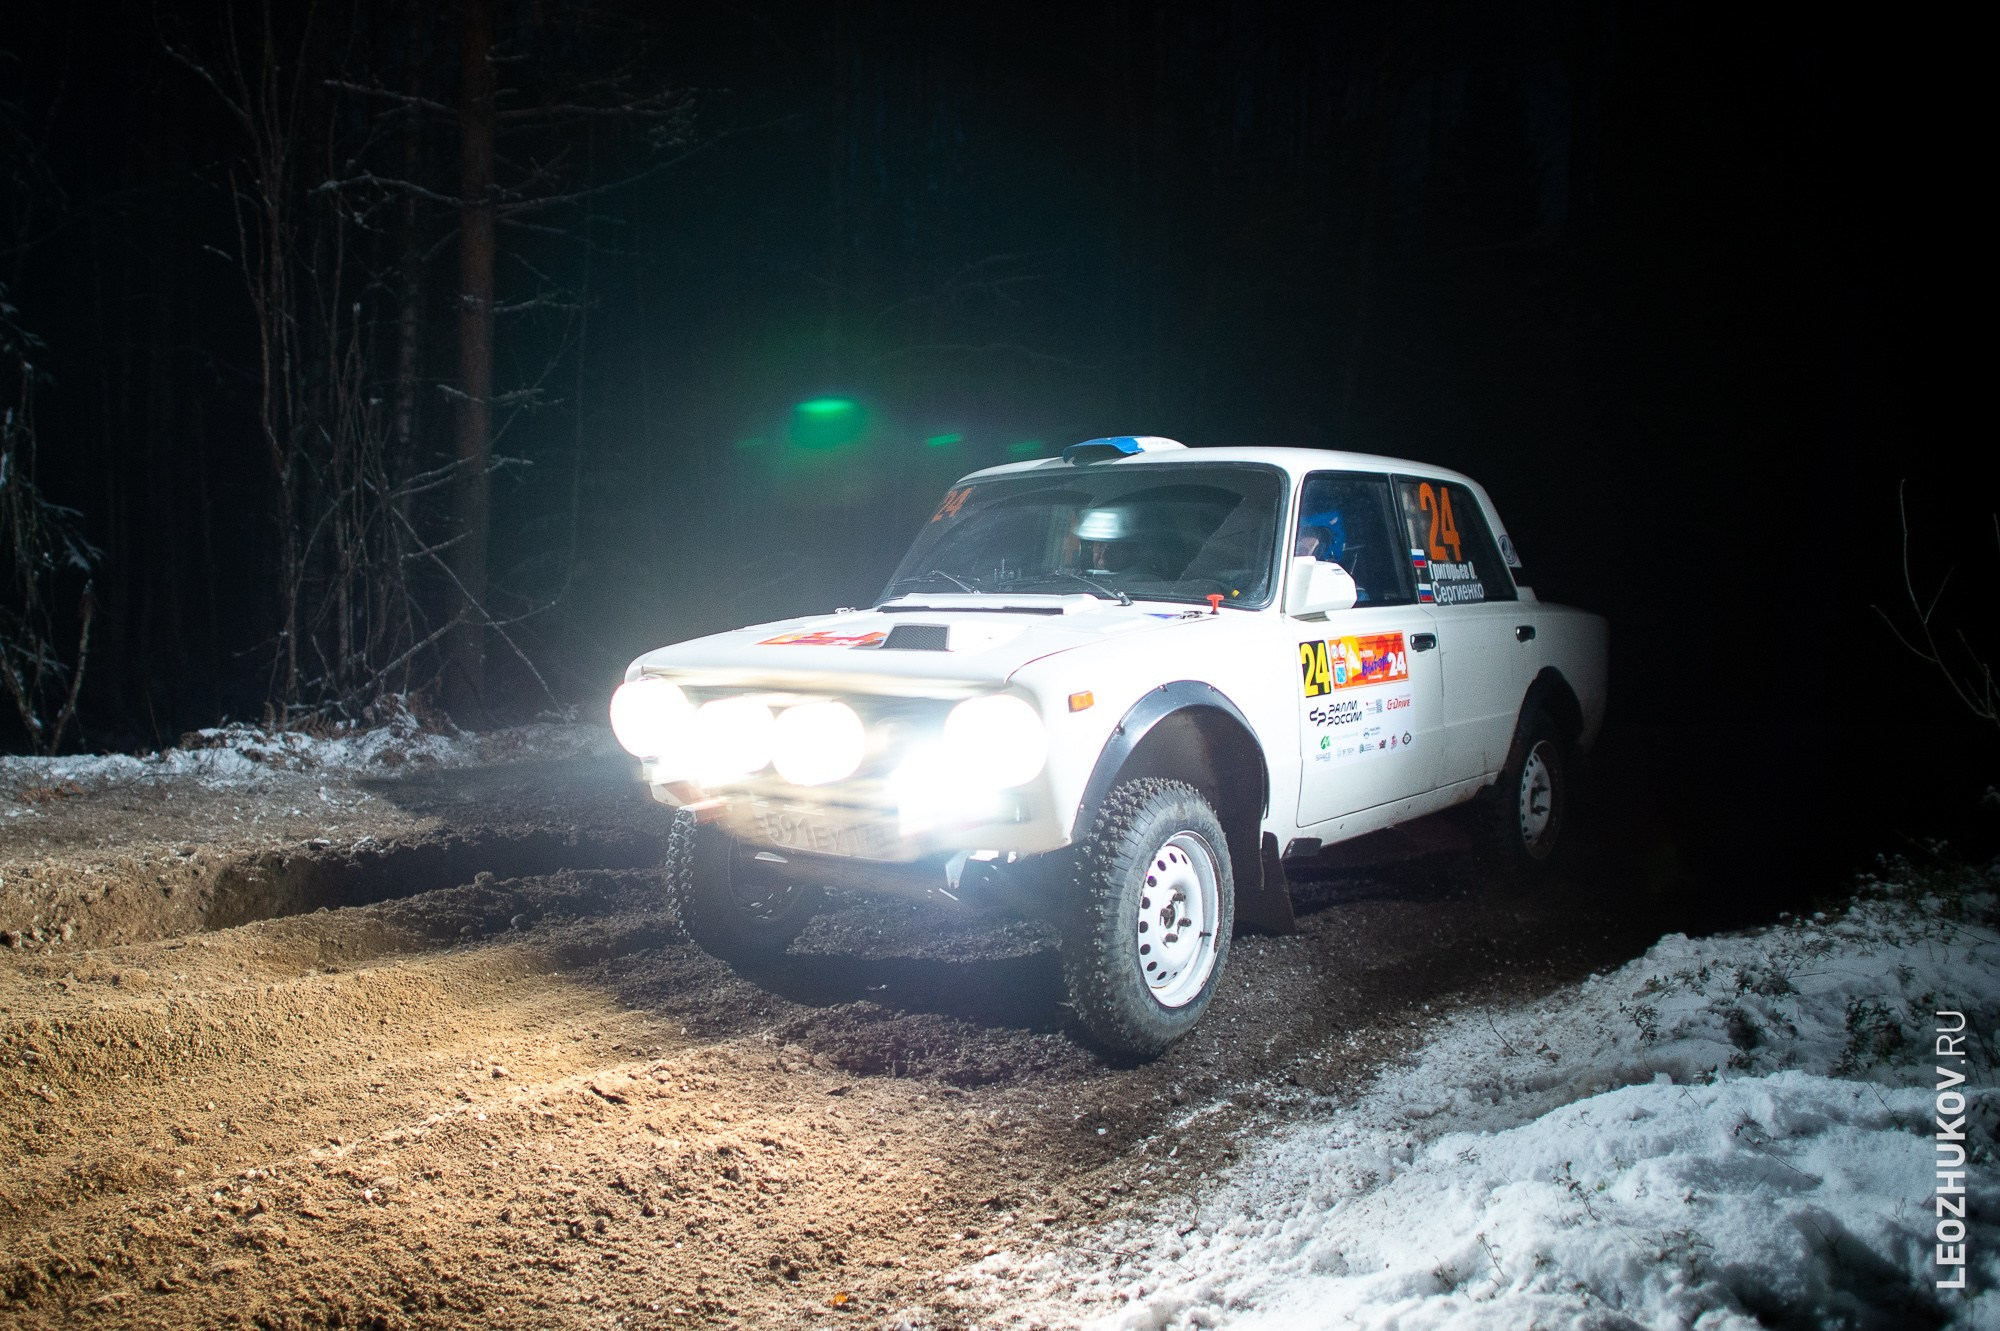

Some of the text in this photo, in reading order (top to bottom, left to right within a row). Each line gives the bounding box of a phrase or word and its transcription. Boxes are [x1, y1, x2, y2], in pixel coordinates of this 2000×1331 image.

[931, 487, 973, 522] 24
[1419, 482, 1463, 561] 24
[1432, 581, 1484, 605] Сергиенко
[1300, 641, 1331, 697] 24
[1387, 651, 1407, 677] 24
[1326, 711, 1363, 728] РОССИИ
[1328, 699, 1358, 715] РАЛЛИ
